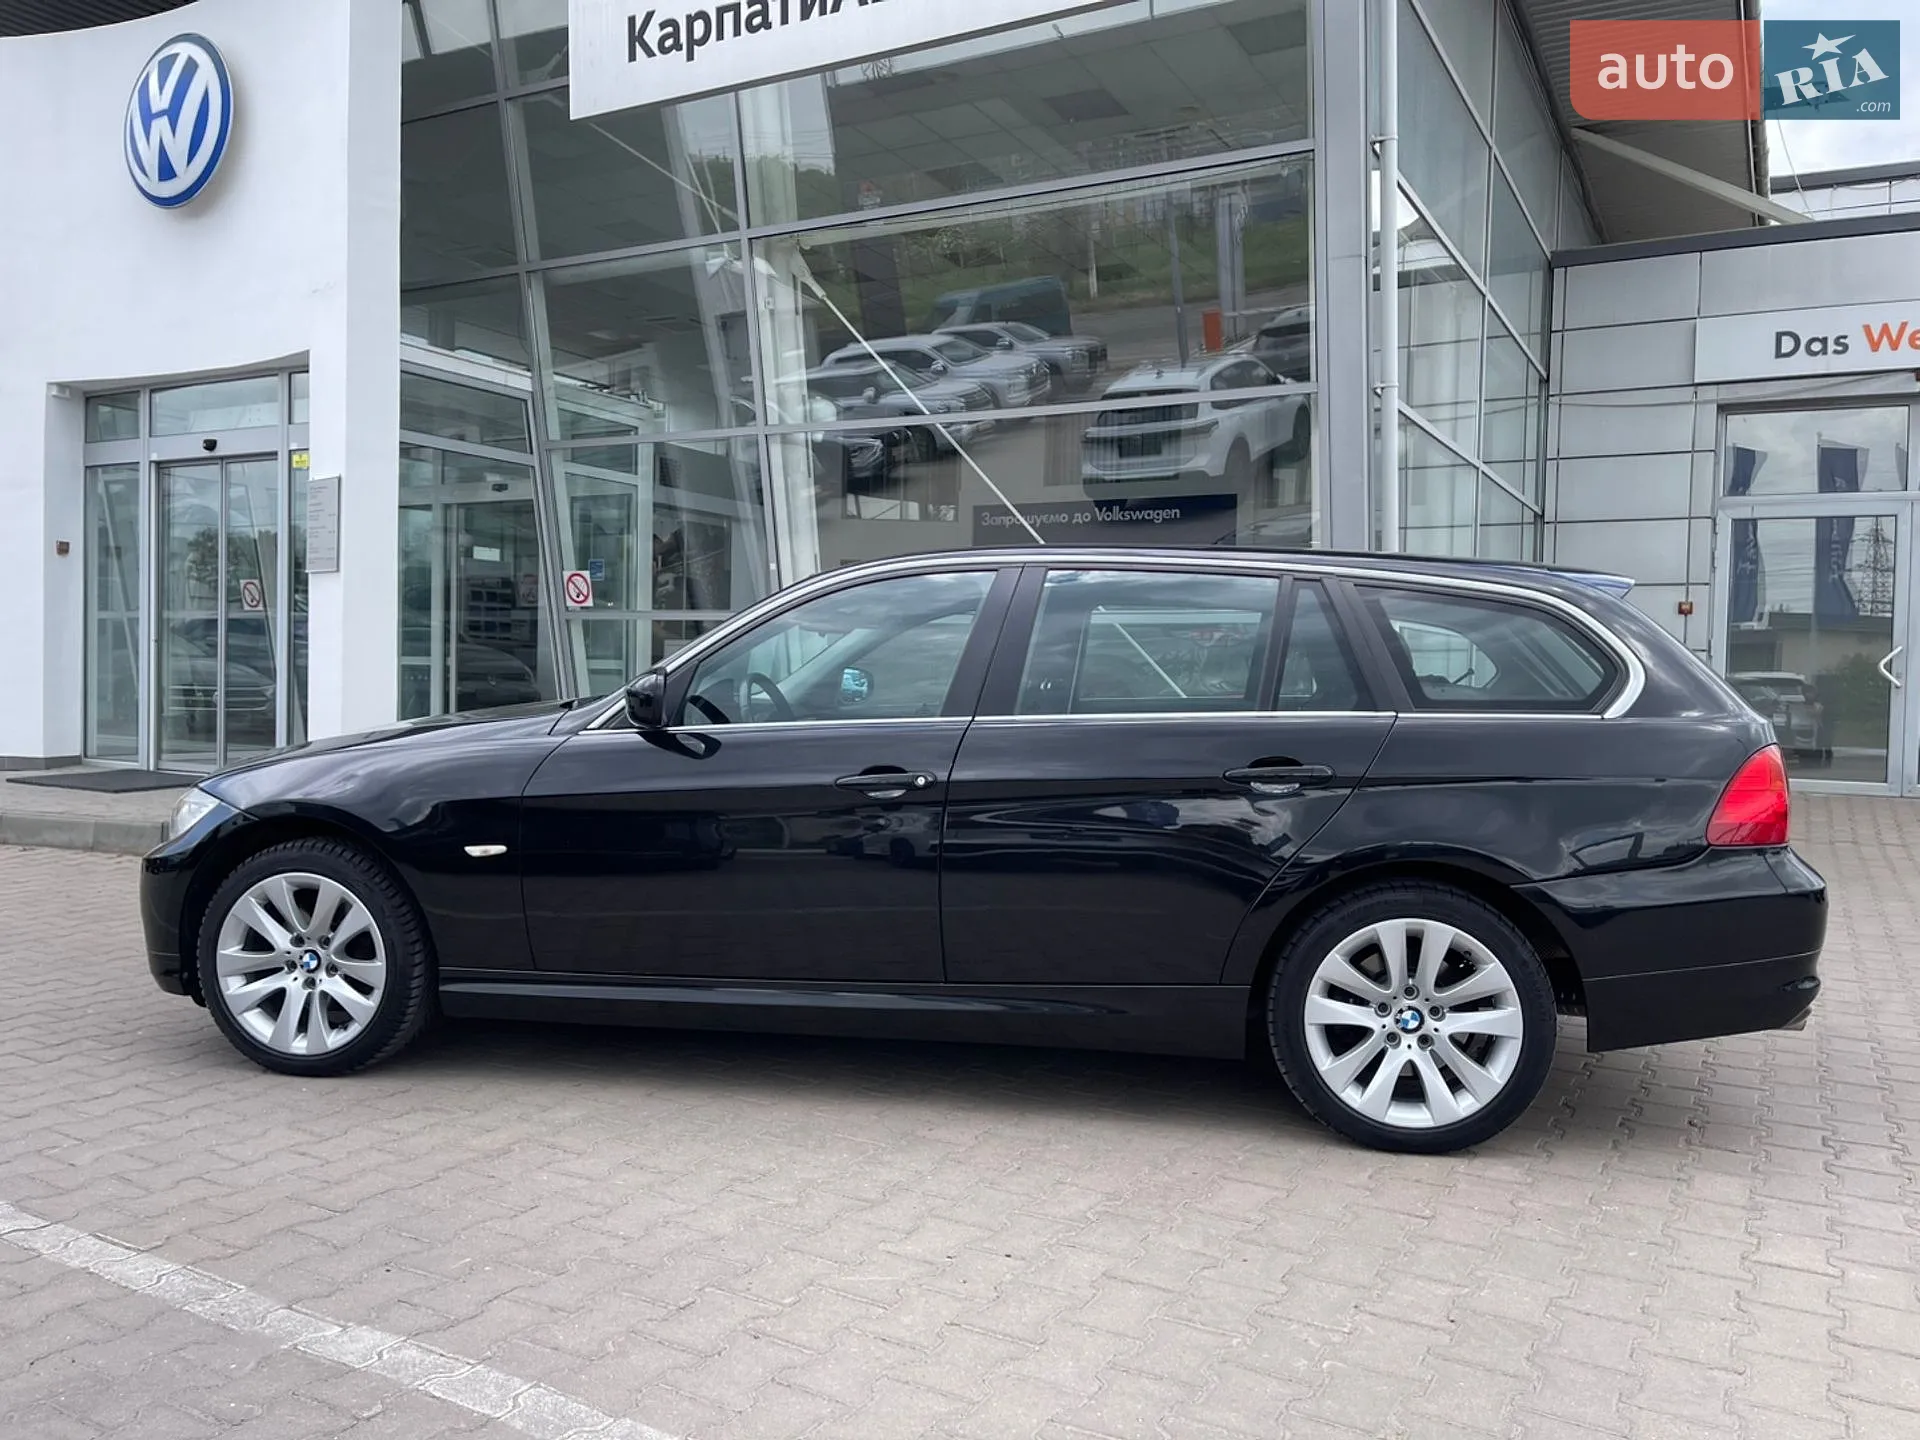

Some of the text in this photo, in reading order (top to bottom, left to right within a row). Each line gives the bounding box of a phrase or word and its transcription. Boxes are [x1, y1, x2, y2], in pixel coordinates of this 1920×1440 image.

[1775, 330, 1850, 359] Das
[1072, 511, 1092, 524] до
[1095, 506, 1181, 523] Volkswagen
